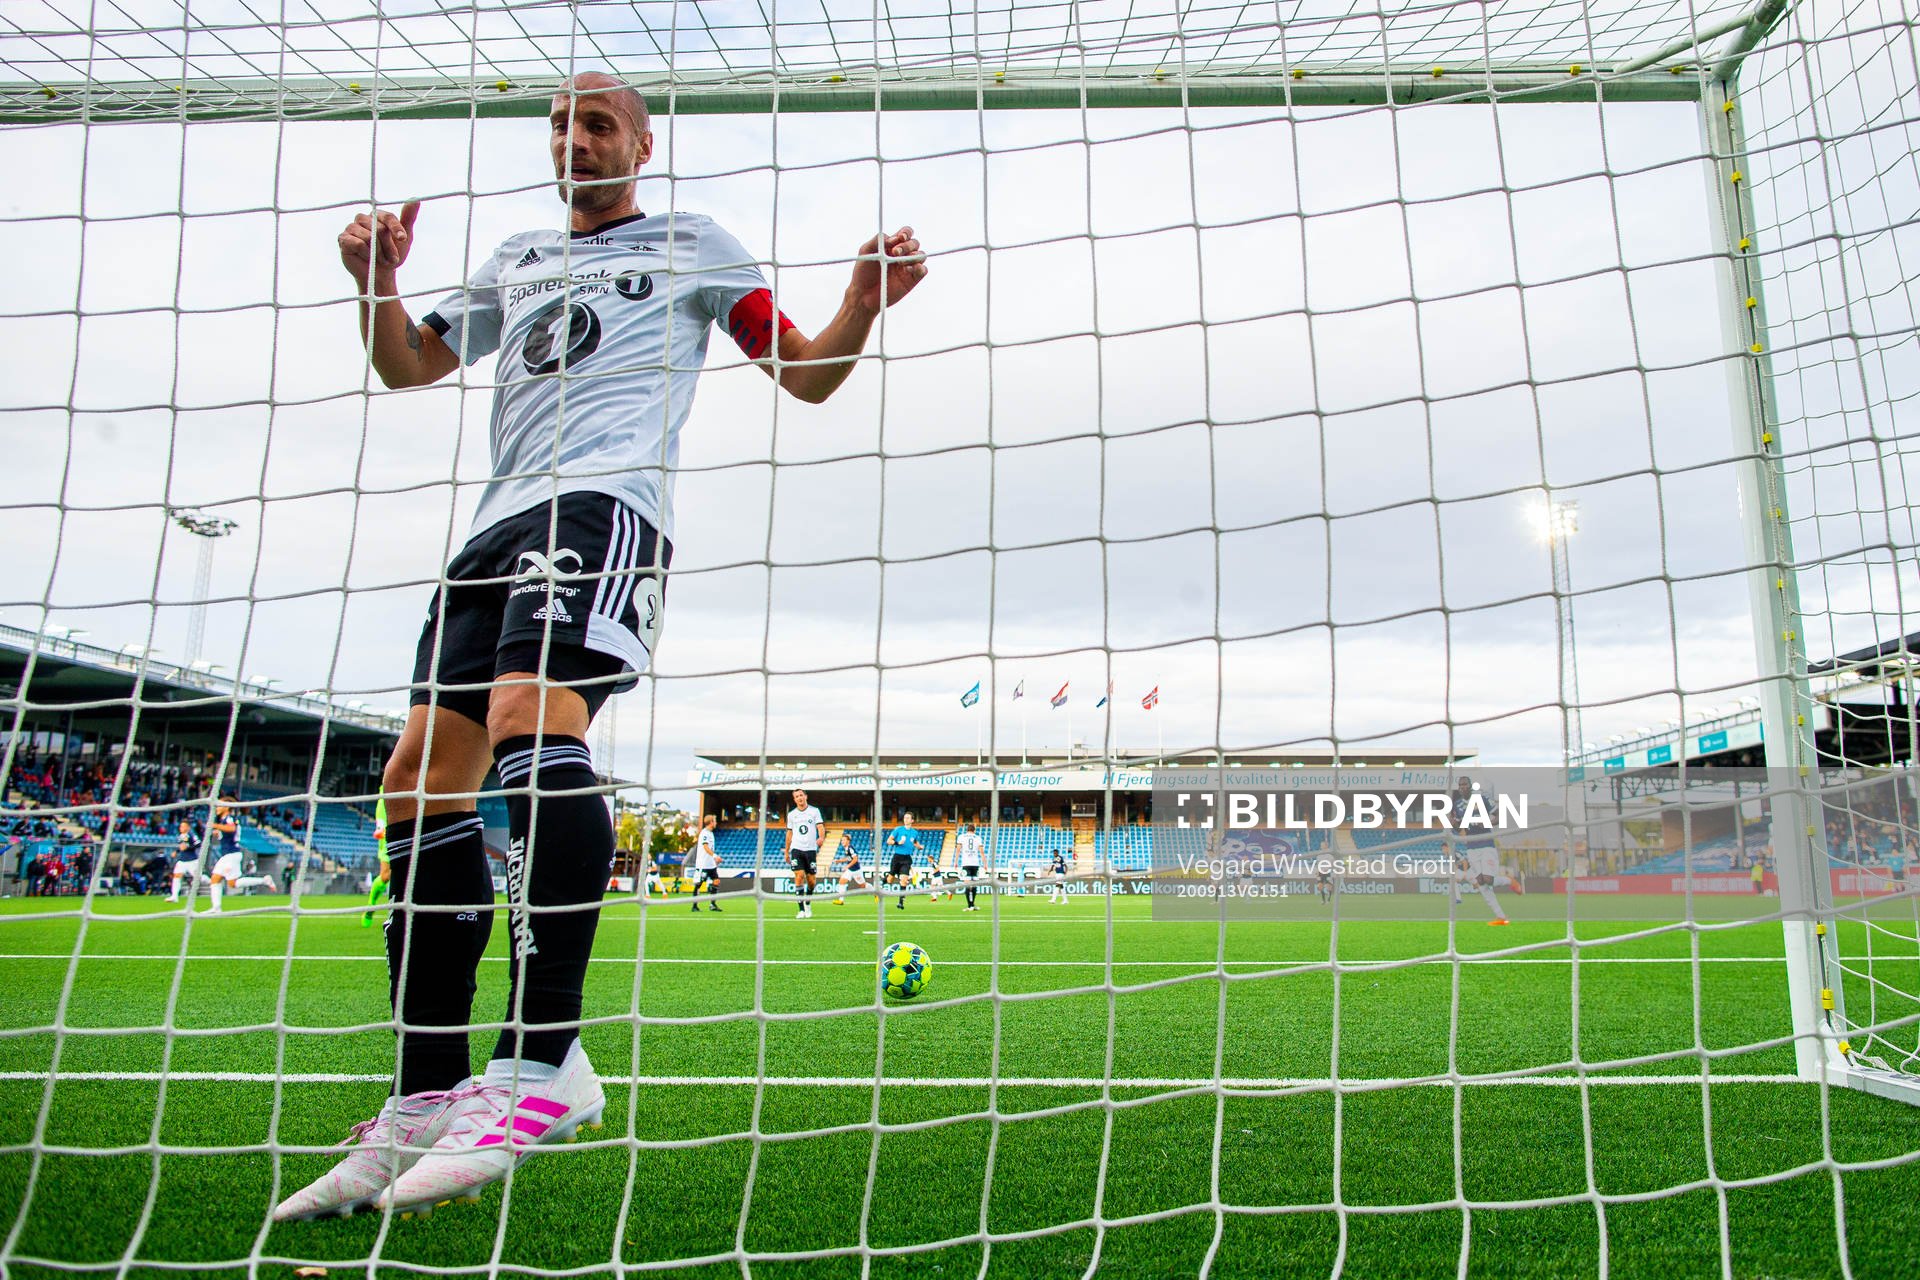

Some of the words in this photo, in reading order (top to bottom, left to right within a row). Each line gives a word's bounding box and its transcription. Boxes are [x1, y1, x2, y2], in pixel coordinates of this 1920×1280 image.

[515, 256, 542, 269] adidas
[579, 286, 610, 295] SMN
[532, 611, 573, 623] addas
[1008, 773, 1063, 787] Magnor
[1117, 773, 1209, 788] Fjerdingstad
[1226, 773, 1279, 785] Kvalitet
[1292, 773, 1383, 788] generasjoner
[1338, 879, 1394, 894] Assiden
